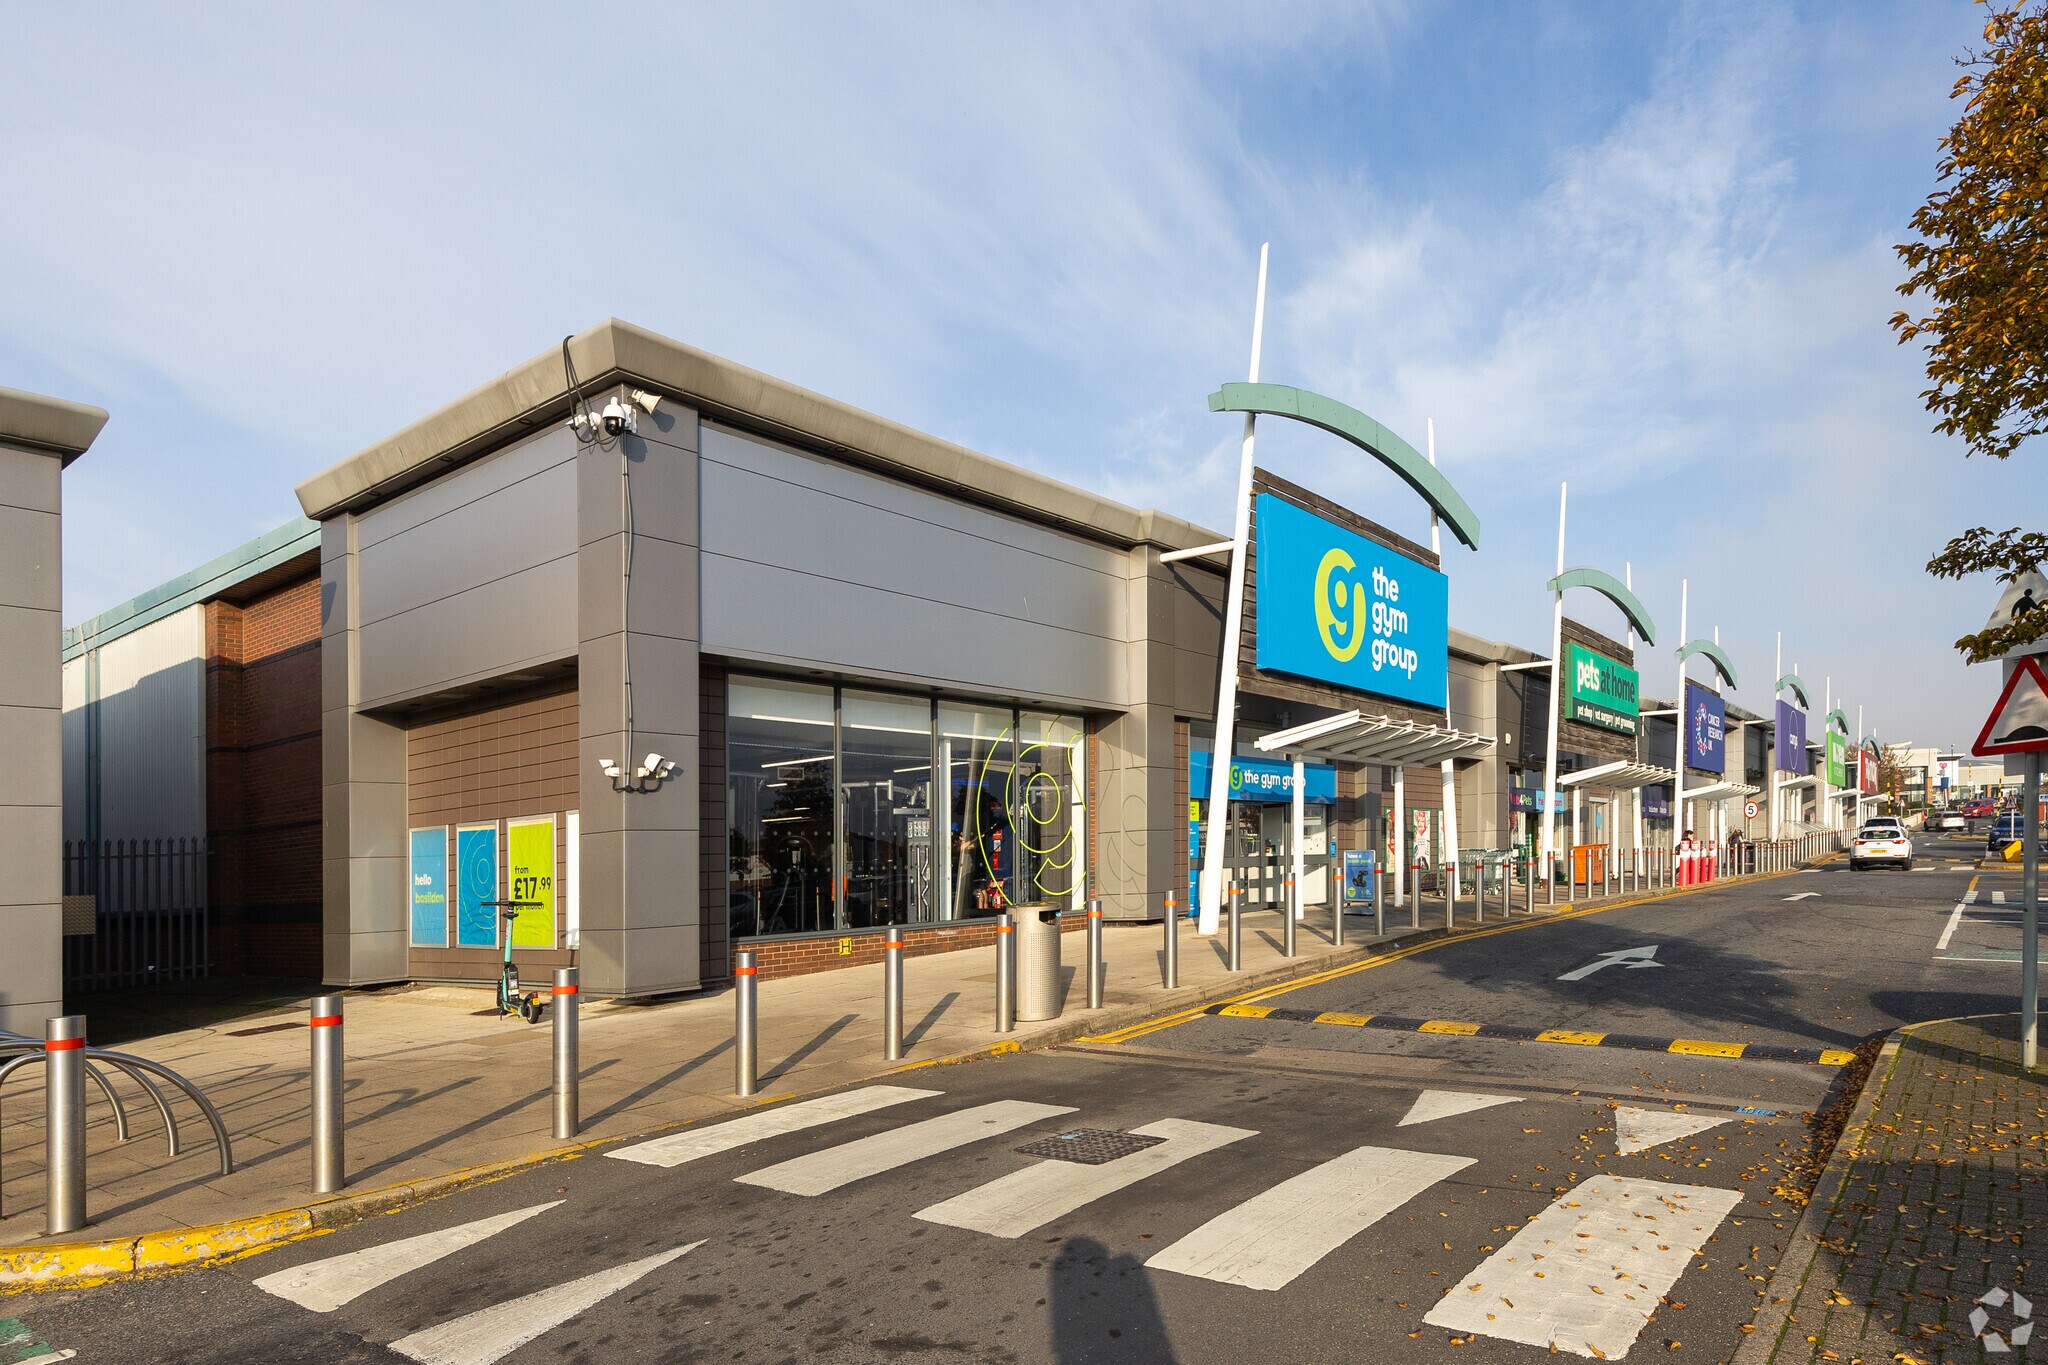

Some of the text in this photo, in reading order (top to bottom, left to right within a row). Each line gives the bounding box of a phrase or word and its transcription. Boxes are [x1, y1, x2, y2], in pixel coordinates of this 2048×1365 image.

[1372, 566, 1399, 602] the
[1372, 601, 1408, 637] gym
[1372, 638, 1418, 680] group
[1577, 658, 1635, 703] pets at home
[1244, 769, 1260, 784] the
[1261, 773, 1281, 789] gym
[1748, 806, 1754, 814] 5
[515, 866, 529, 874] from
[415, 874, 432, 886] hello
[415, 892, 444, 904] basildon
[842, 940, 850, 954] H
